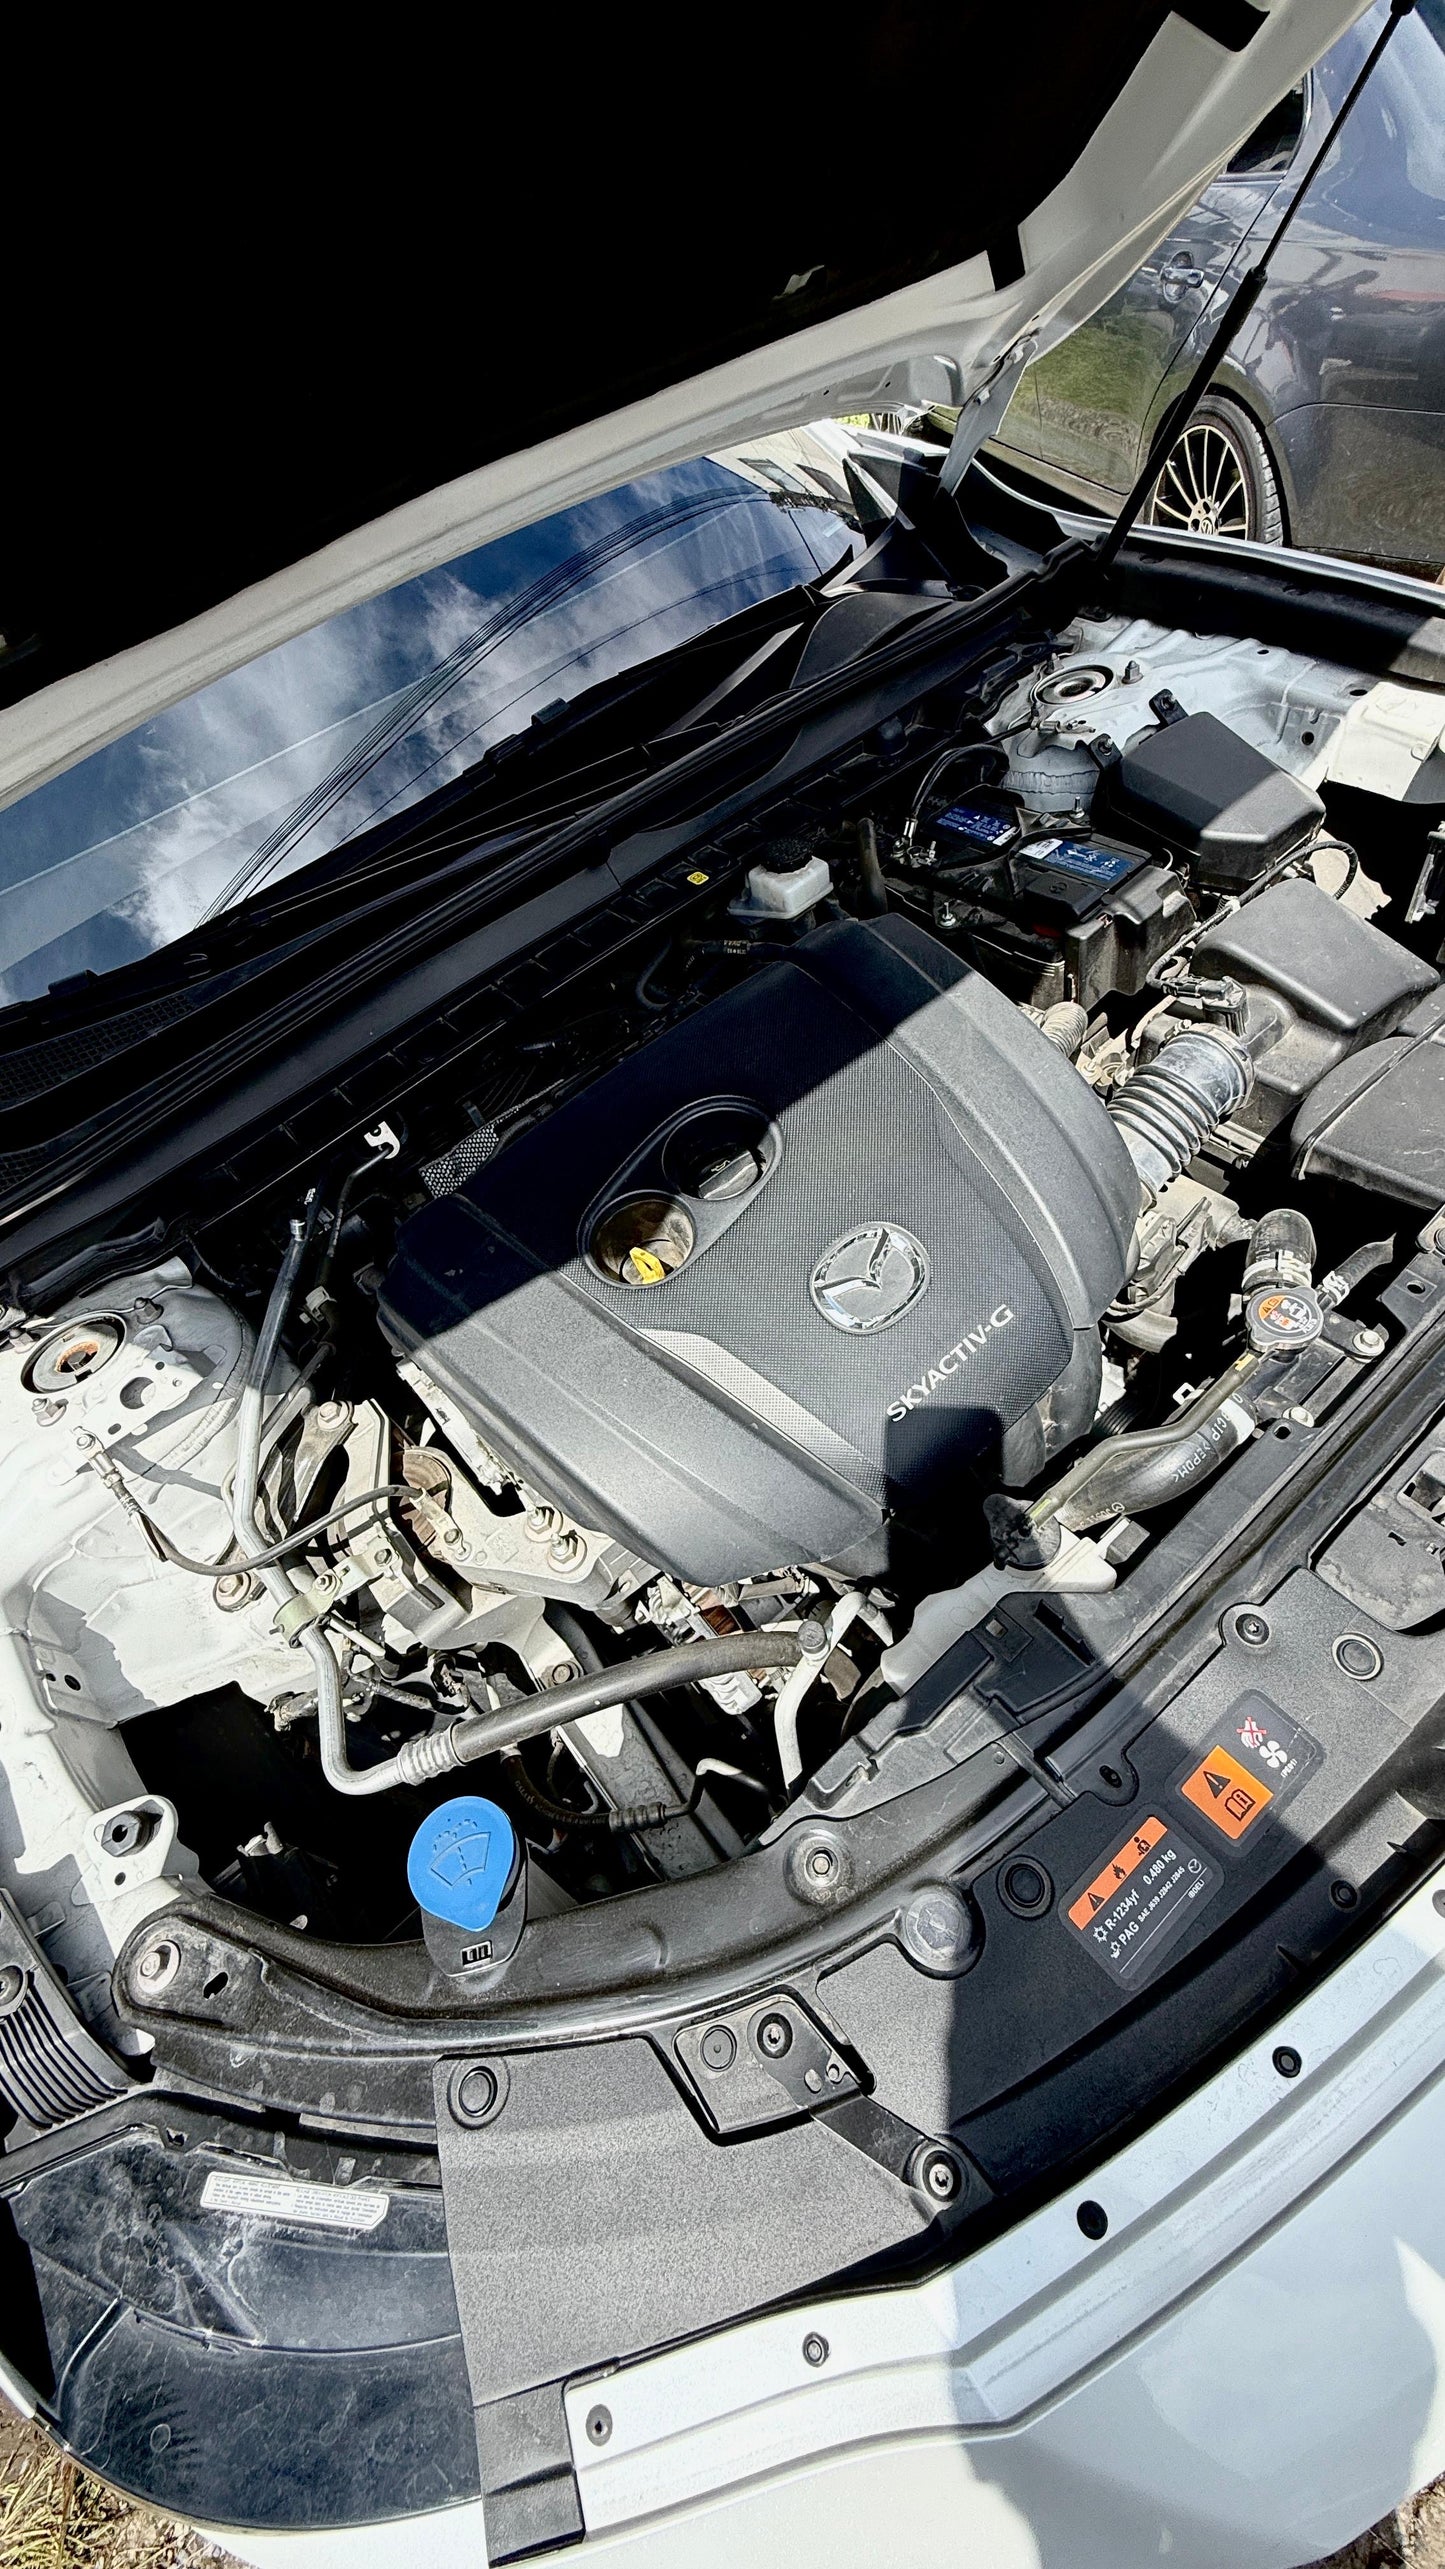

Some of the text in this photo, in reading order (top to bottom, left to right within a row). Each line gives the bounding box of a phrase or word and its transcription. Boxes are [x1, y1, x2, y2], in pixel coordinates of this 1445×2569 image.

[886, 1303, 1015, 1422] SKYACTIV-G
[1105, 1849, 1177, 1930] R-1234yf 0.480 kg
[1118, 1921, 1139, 1945] PAG
[1138, 1908, 1150, 1922] SAE
